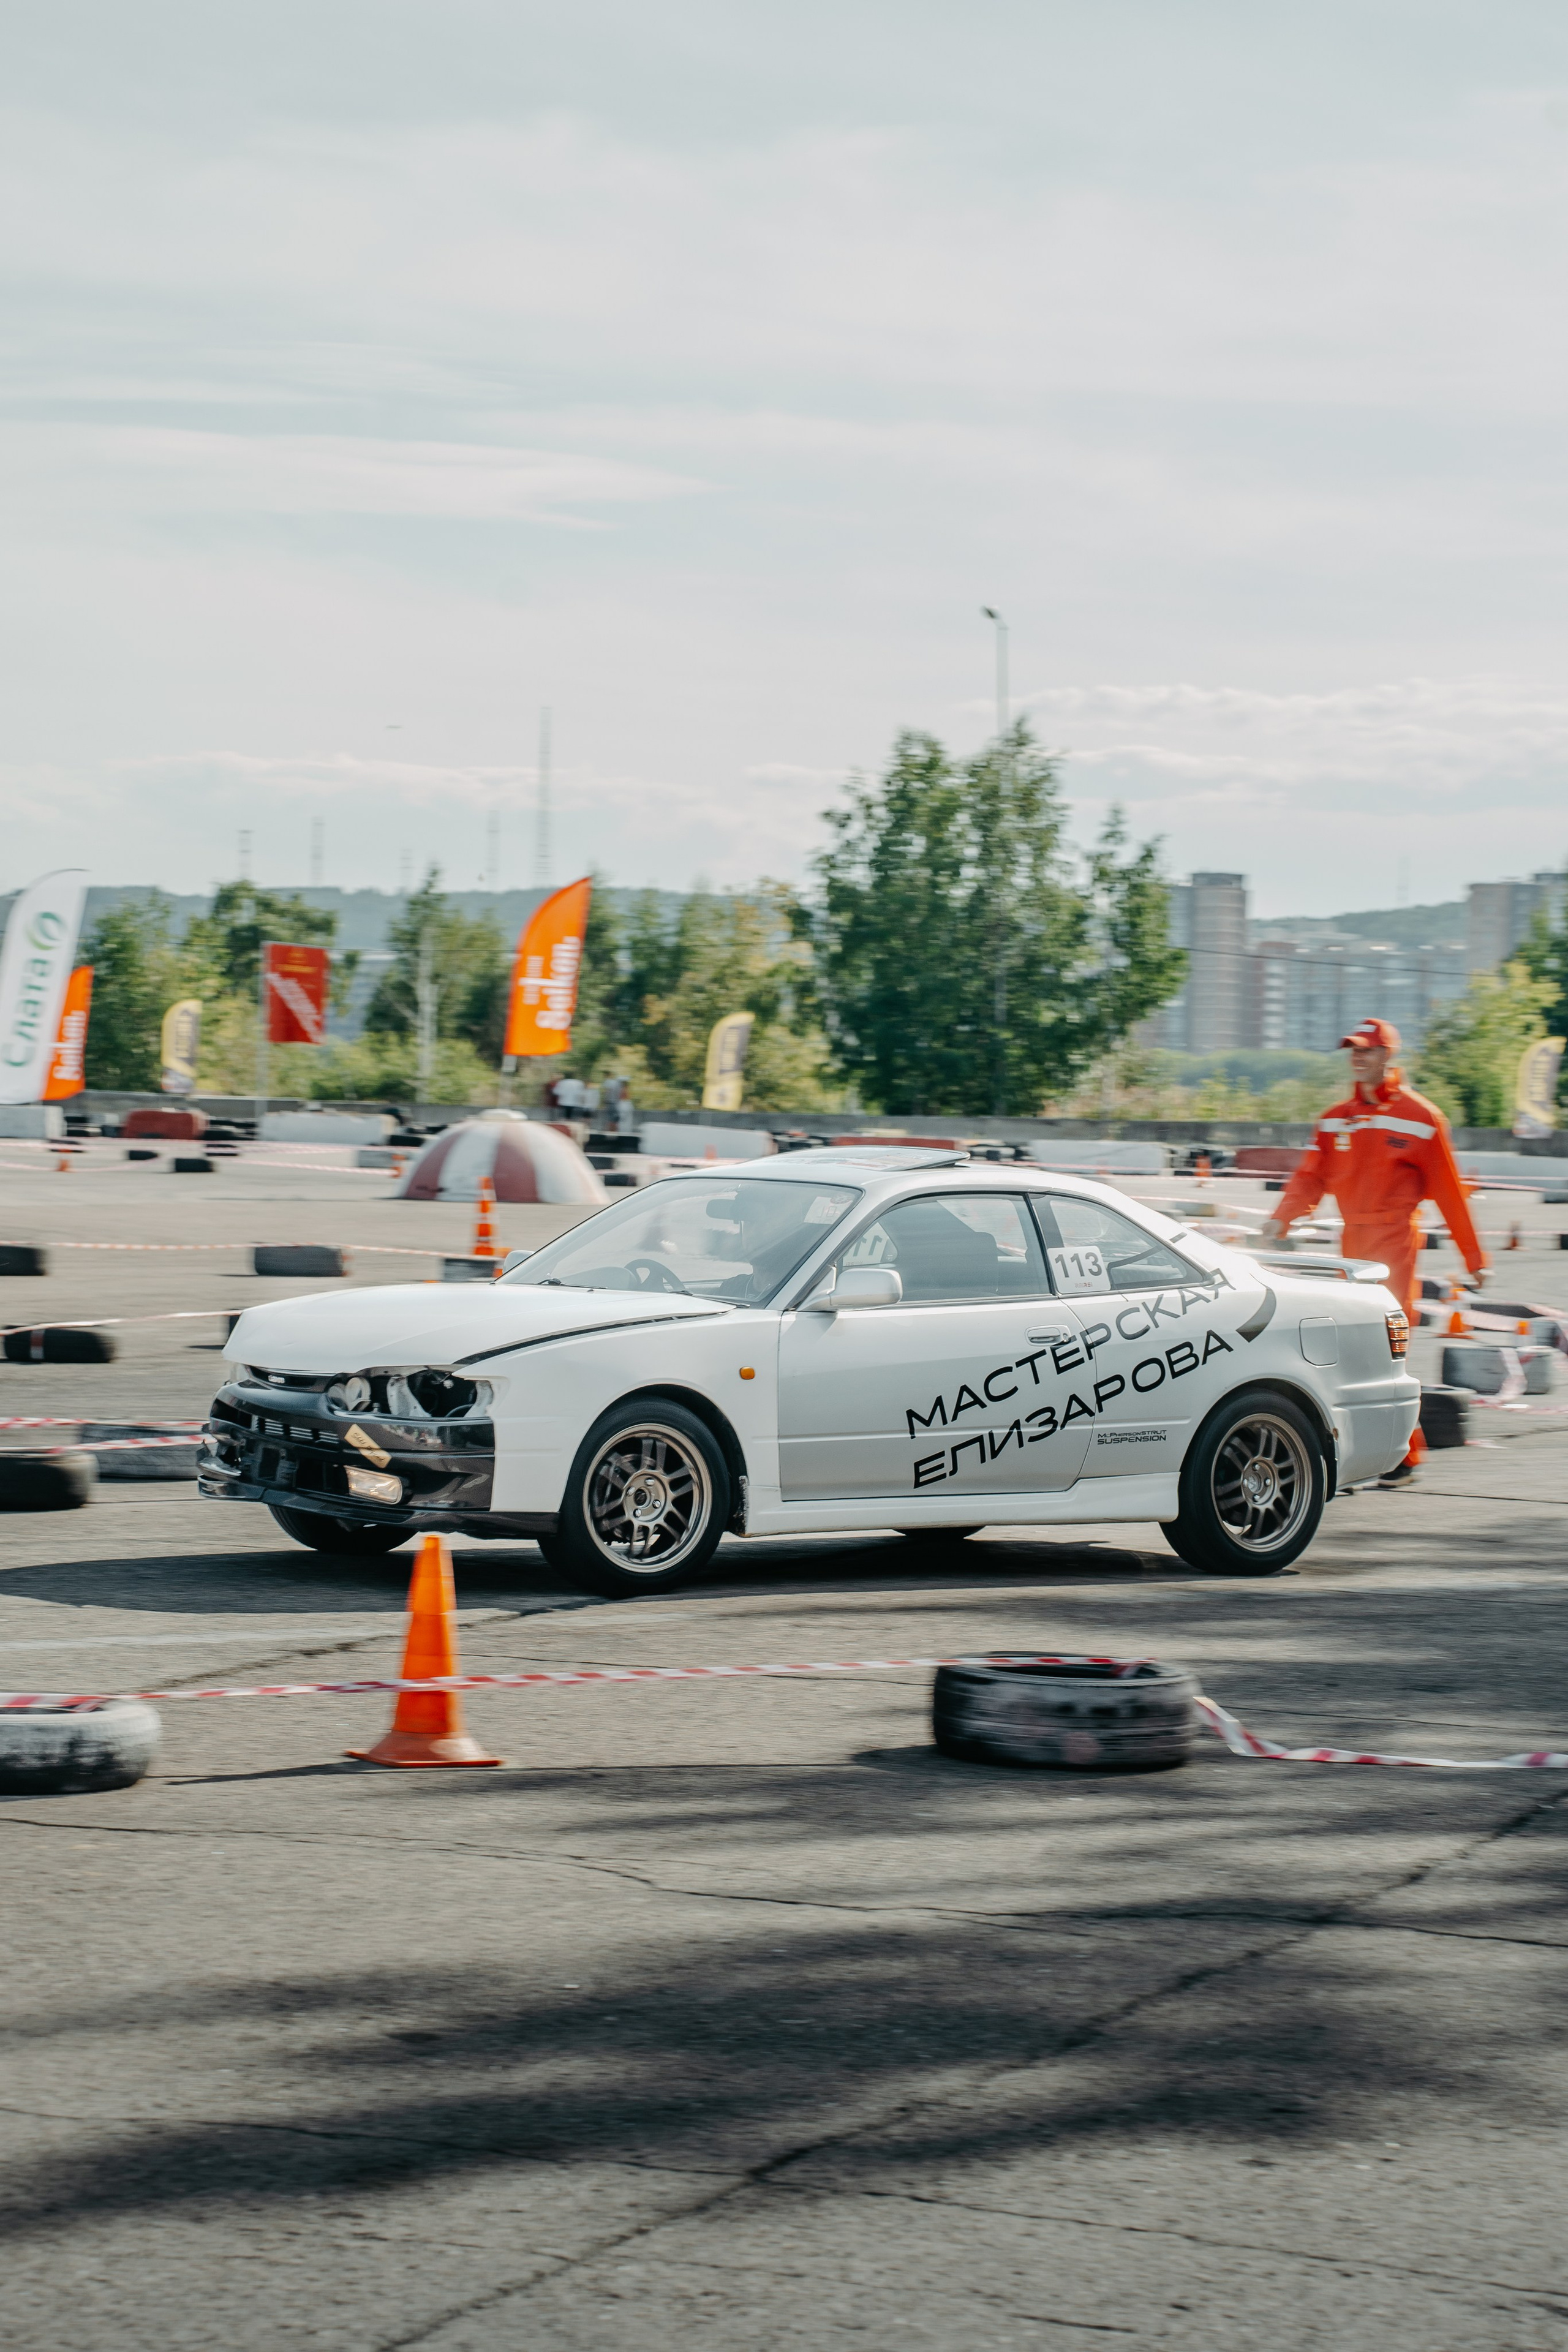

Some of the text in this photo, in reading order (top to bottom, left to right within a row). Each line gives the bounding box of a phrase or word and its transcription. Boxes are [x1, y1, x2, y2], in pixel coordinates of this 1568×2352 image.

[1055, 1252, 1102, 1278] 113
[906, 1268, 1236, 1439] МАСТЕРСКАЯ
[913, 1329, 1234, 1489] ЕЛИЗАРОВА
[1098, 1435, 1166, 1444] SUSPENSION
